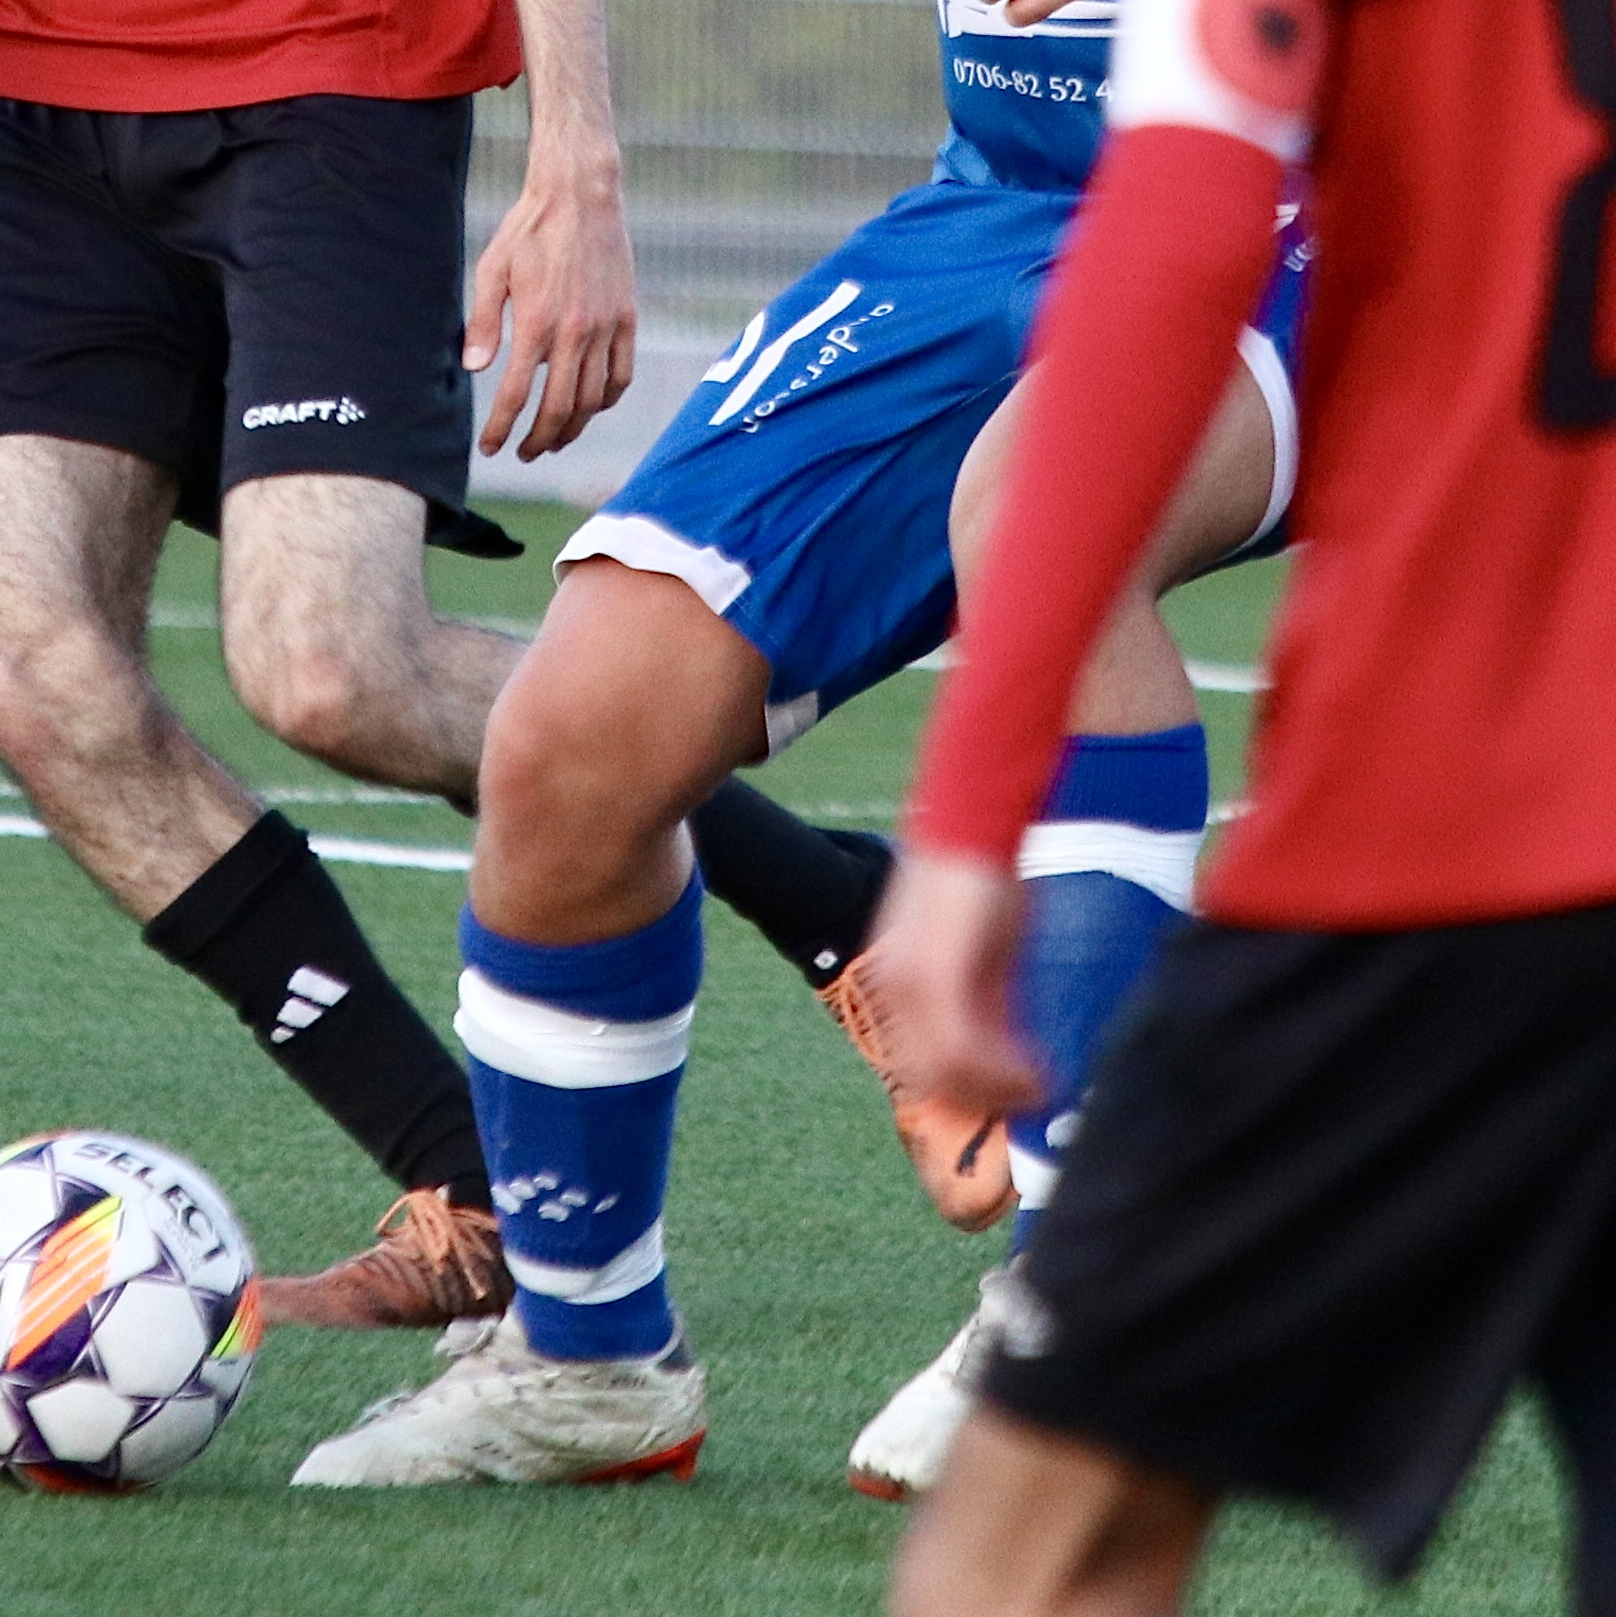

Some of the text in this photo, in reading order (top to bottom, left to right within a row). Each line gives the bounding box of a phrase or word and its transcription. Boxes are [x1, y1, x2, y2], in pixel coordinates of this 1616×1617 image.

[953, 58, 1043, 98] 0706-82
[1049, 76, 1087, 102] 52
[242, 400, 338, 430] CRAFT
[73, 1142, 229, 1263] SELECT
